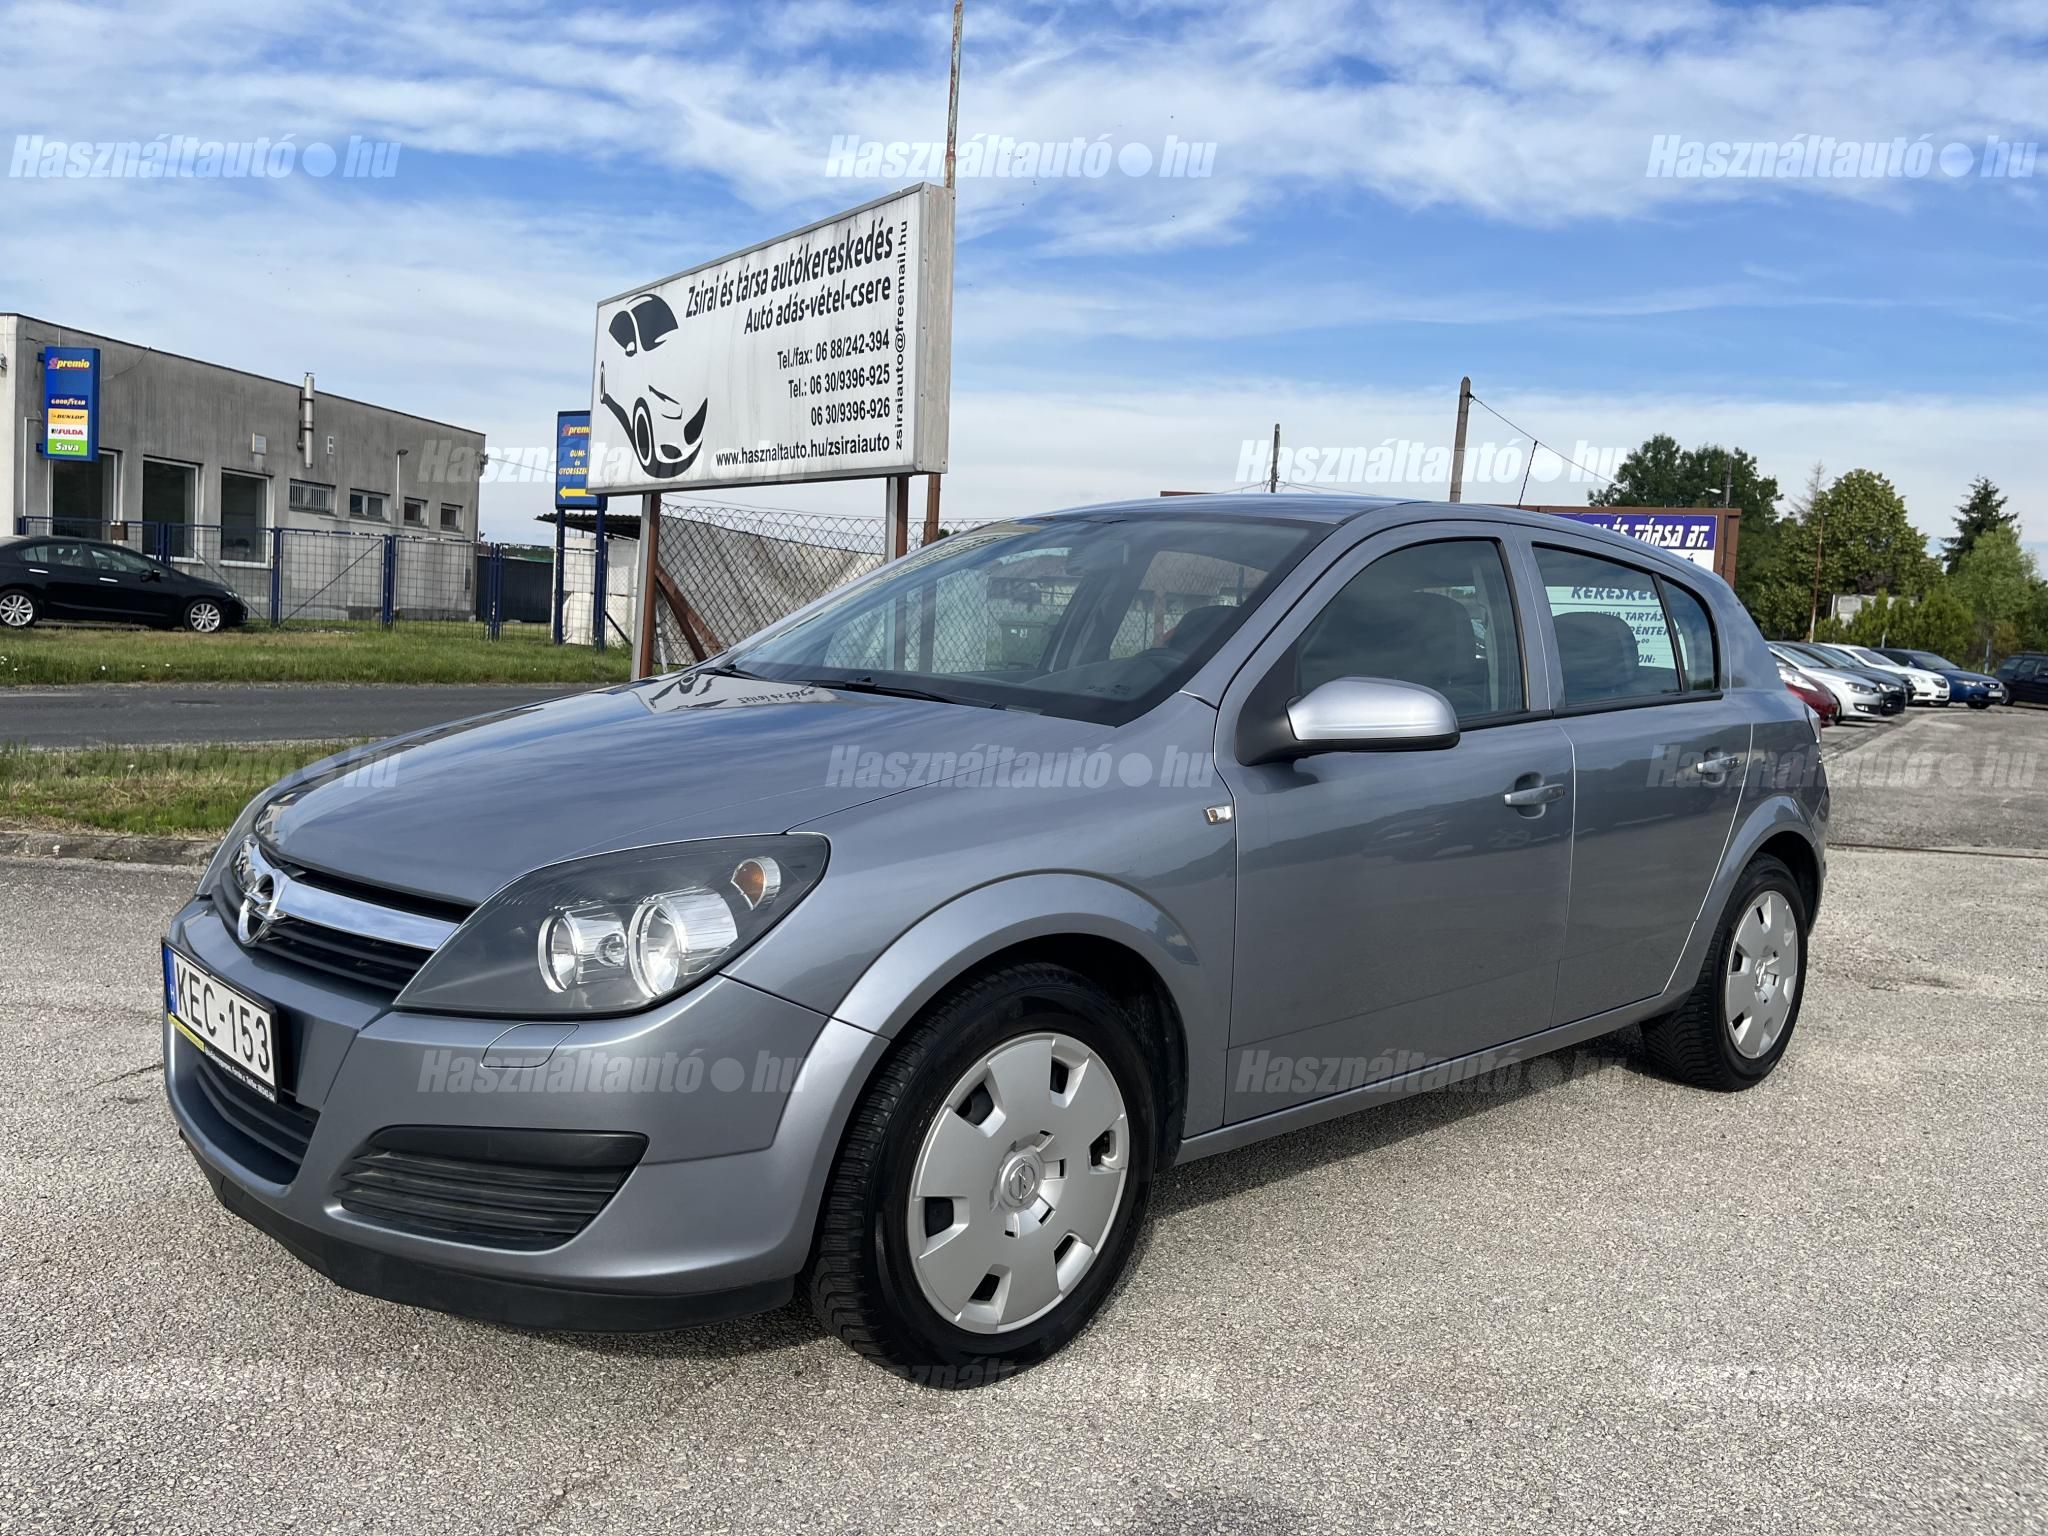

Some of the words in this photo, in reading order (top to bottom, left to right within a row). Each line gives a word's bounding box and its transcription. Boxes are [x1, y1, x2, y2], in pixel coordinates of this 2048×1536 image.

[686, 273, 719, 318] Zsirai
[720, 272, 733, 308] és
[736, 264, 769, 303] társa
[771, 216, 894, 289] autókereskedés
[744, 304, 773, 334] Autó
[776, 275, 891, 326] adás-vétel-csere
[777, 346, 813, 370] Tel./fax:
[816, 341, 828, 362] 06
[830, 329, 890, 359] 88/242-394
[894, 220, 907, 450] zsiraiauto@freemail.hu
[57, 358, 90, 369] premio
[788, 379, 807, 399] Tel.:
[810, 376, 823, 395] 06
[824, 364, 890, 391] 30/9396-925
[51, 398, 86, 406] GOODYEAR
[811, 407, 823, 426] 06
[825, 397, 890, 425] 30/9396-926
[55, 442, 79, 451] Sava
[716, 435, 890, 467] www.hasznaltauto.hu/zsiraiauto
[1634, 518, 1684, 547] TÁRSA
[1685, 525, 1710, 547] BT.
[176, 962, 270, 1073] KEC-153
